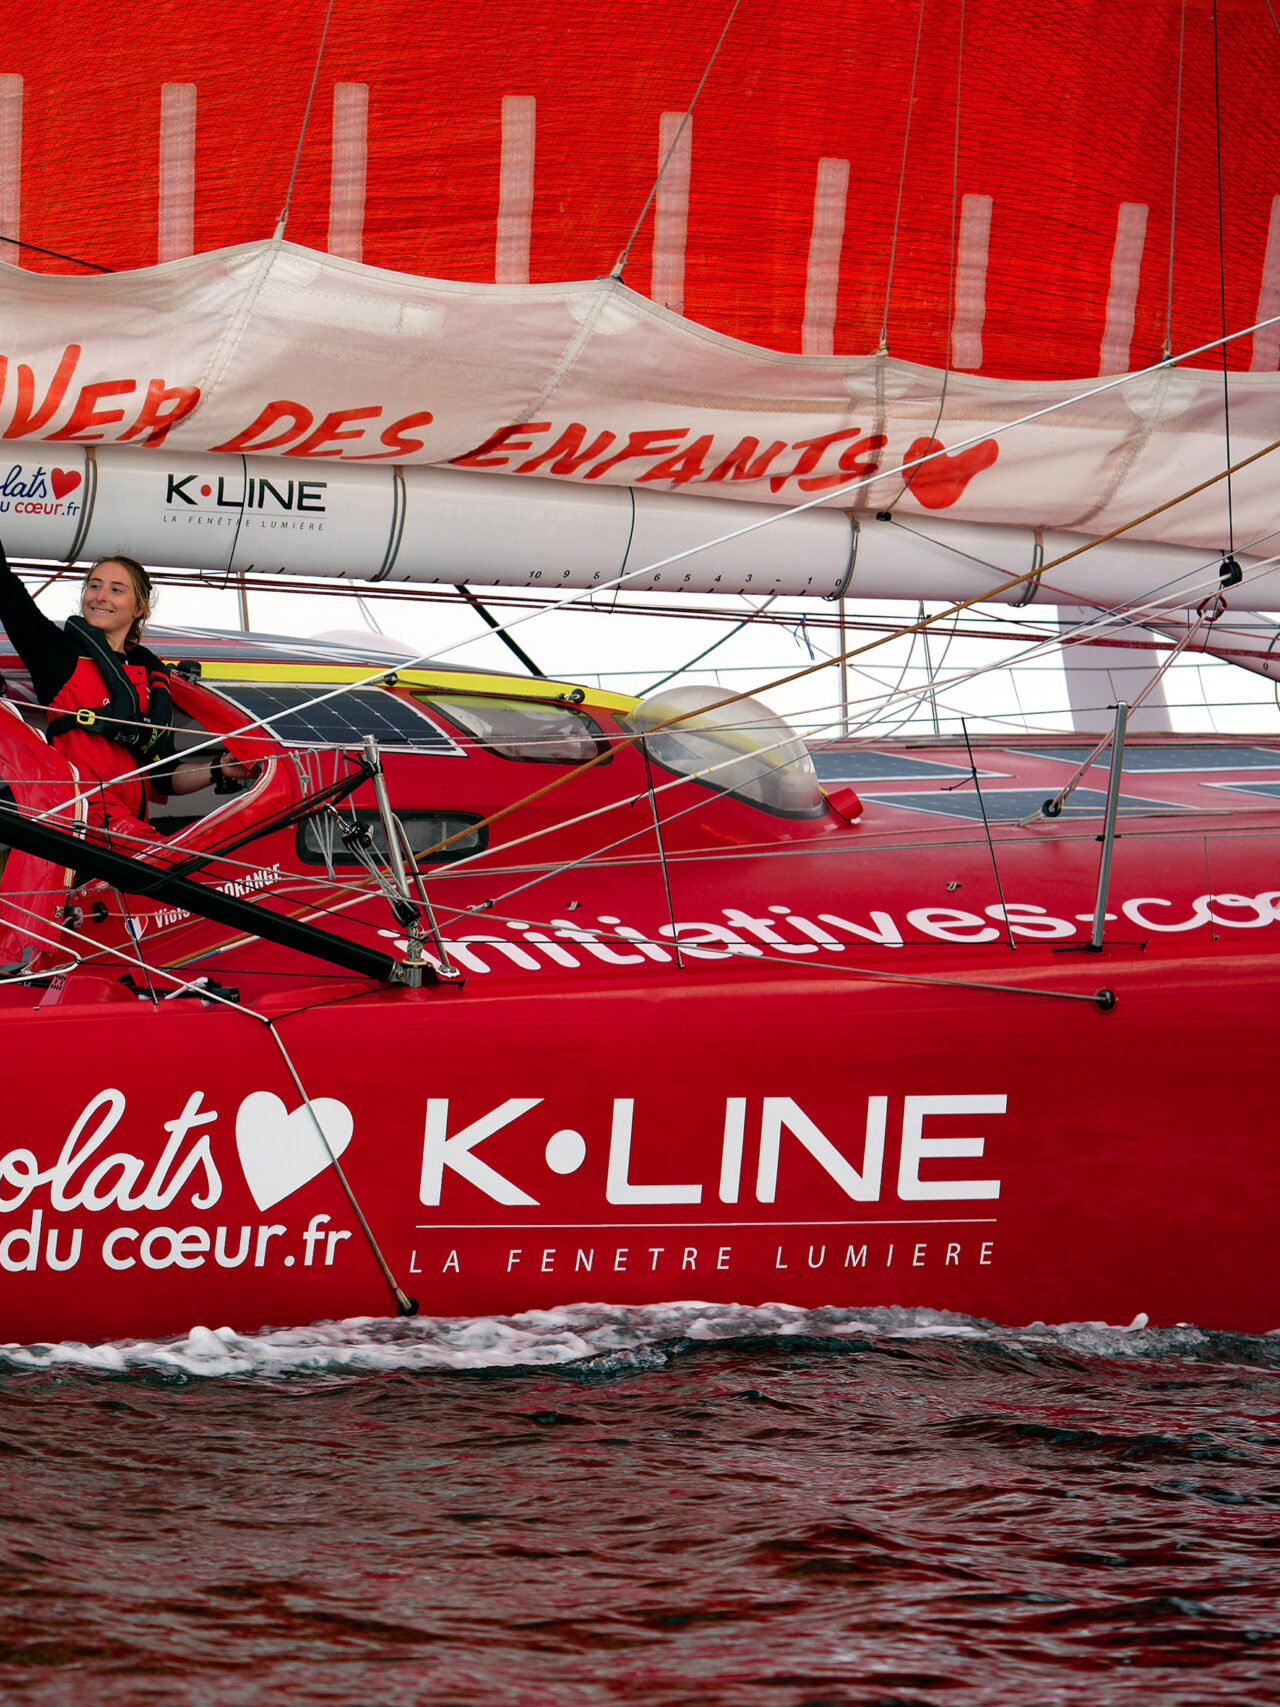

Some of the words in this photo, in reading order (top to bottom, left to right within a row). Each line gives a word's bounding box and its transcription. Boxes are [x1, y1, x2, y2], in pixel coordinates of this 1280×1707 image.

[206, 400, 434, 460] DES
[446, 421, 889, 493] ENFANTS
[163, 515, 177, 523] LA
[529, 570, 542, 579] 10
[562, 570, 571, 578] 9
[683, 573, 692, 582] 5
[102, 1214, 353, 1271] cœur.fr
[409, 1248, 462, 1274] LA
[507, 1244, 734, 1273] FENETRE
[775, 1240, 996, 1270] LUMIERE
